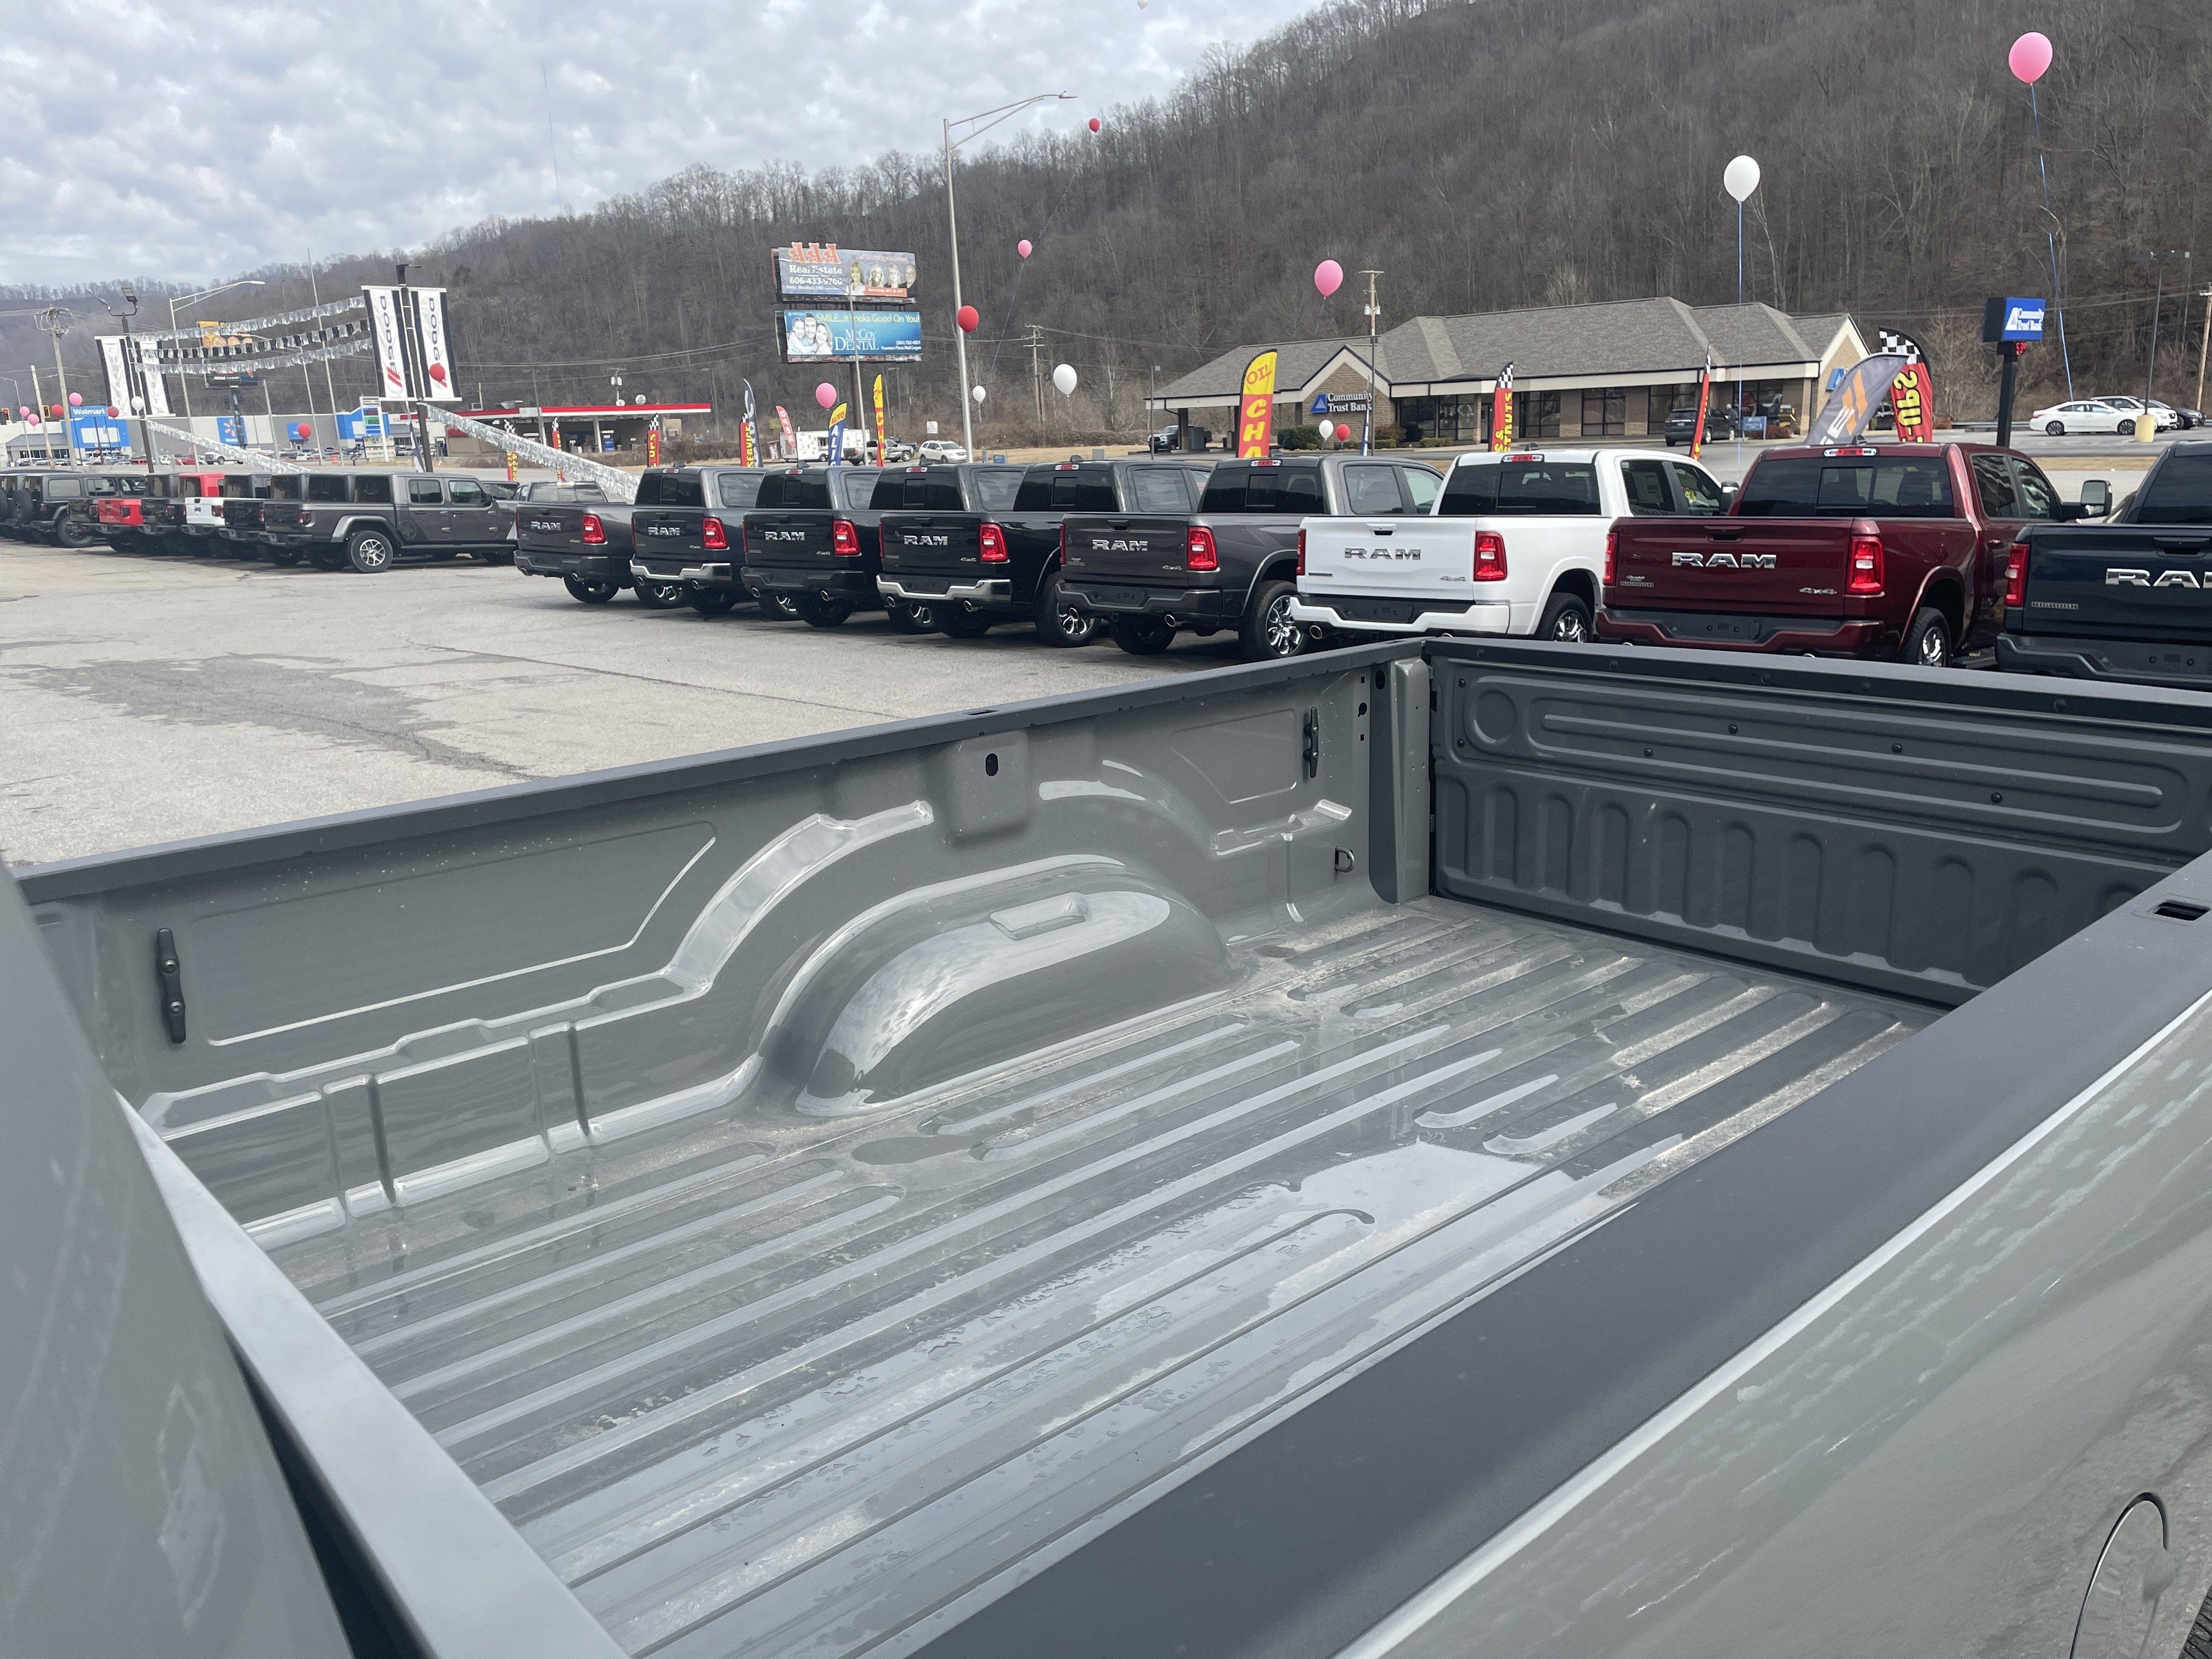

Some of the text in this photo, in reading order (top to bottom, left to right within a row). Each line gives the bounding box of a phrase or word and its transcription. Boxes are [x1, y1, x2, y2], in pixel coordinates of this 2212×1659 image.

[788, 241, 842, 264] AAA
[789, 264, 843, 275] Real Estate
[871, 313, 893, 323] Good
[893, 314, 904, 323] On
[380, 295, 397, 374] DODGE
[428, 297, 441, 364] DODG
[834, 336, 879, 351] DENTAL
[1246, 364, 1272, 385] OIL
[1328, 402, 1373, 412] Trust Bank
[531, 521, 561, 531] RAM
[648, 527, 680, 536] RAM
[765, 532, 805, 541] RAM
[904, 535, 948, 546] RAM
[1092, 539, 1148, 551] RAM
[1344, 548, 1421, 560] RAM
[1672, 552, 1777, 569] RAM
[2106, 568, 2212, 589] RA
[1799, 586, 1837, 595] 4x4
